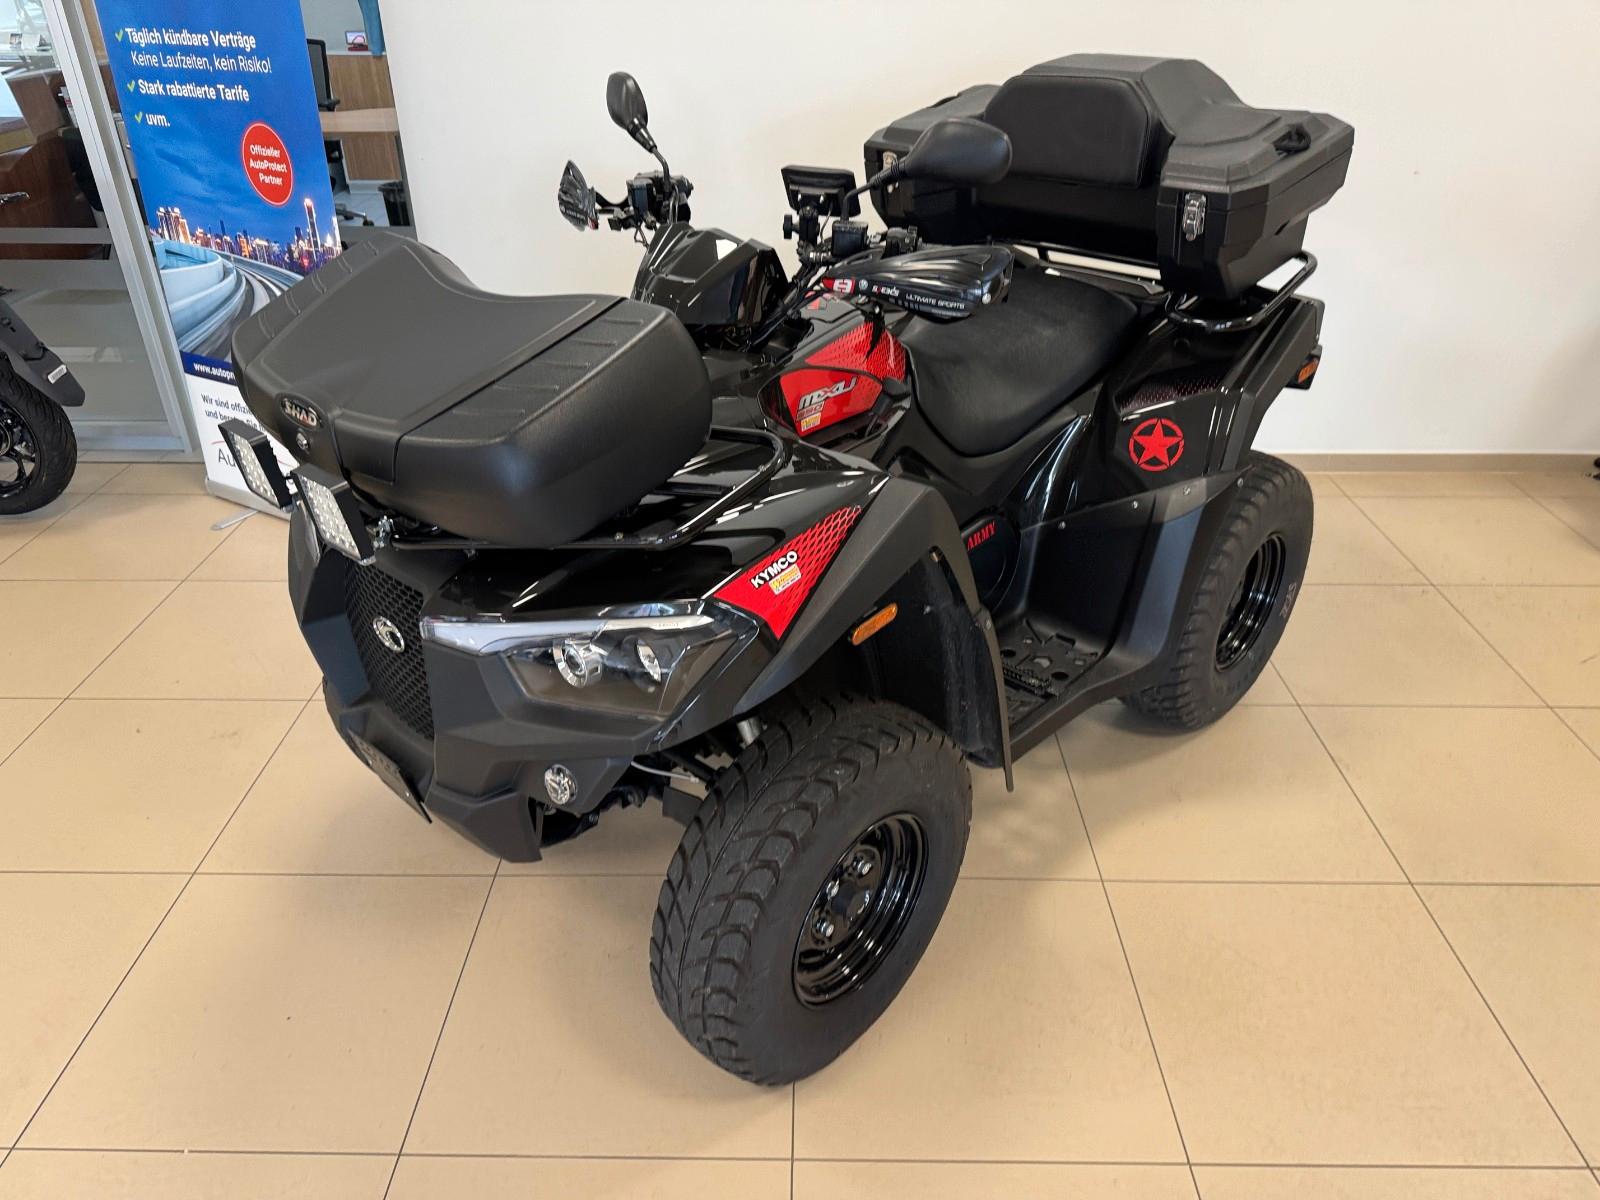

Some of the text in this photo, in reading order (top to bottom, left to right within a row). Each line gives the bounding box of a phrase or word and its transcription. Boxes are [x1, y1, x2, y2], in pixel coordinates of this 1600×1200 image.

[125, 28, 256, 52] Täglich kündbare Verträge
[131, 51, 272, 73] Keine Laufzeiten, kein Risiko!
[138, 79, 249, 102] Stark rabattierte Tarife
[146, 113, 170, 127] uvm.
[249, 144, 280, 158] Offizieller
[249, 158, 287, 173] AutoProtect
[259, 172, 283, 186] Partner
[906, 293, 936, 304] ULTIMATE
[201, 393, 213, 405] Wir
[215, 397, 229, 410] sind
[205, 409, 218, 420] und
[284, 398, 317, 427] SHAD
[967, 520, 995, 551] ARMY
[751, 551, 798, 588] KYMCO
